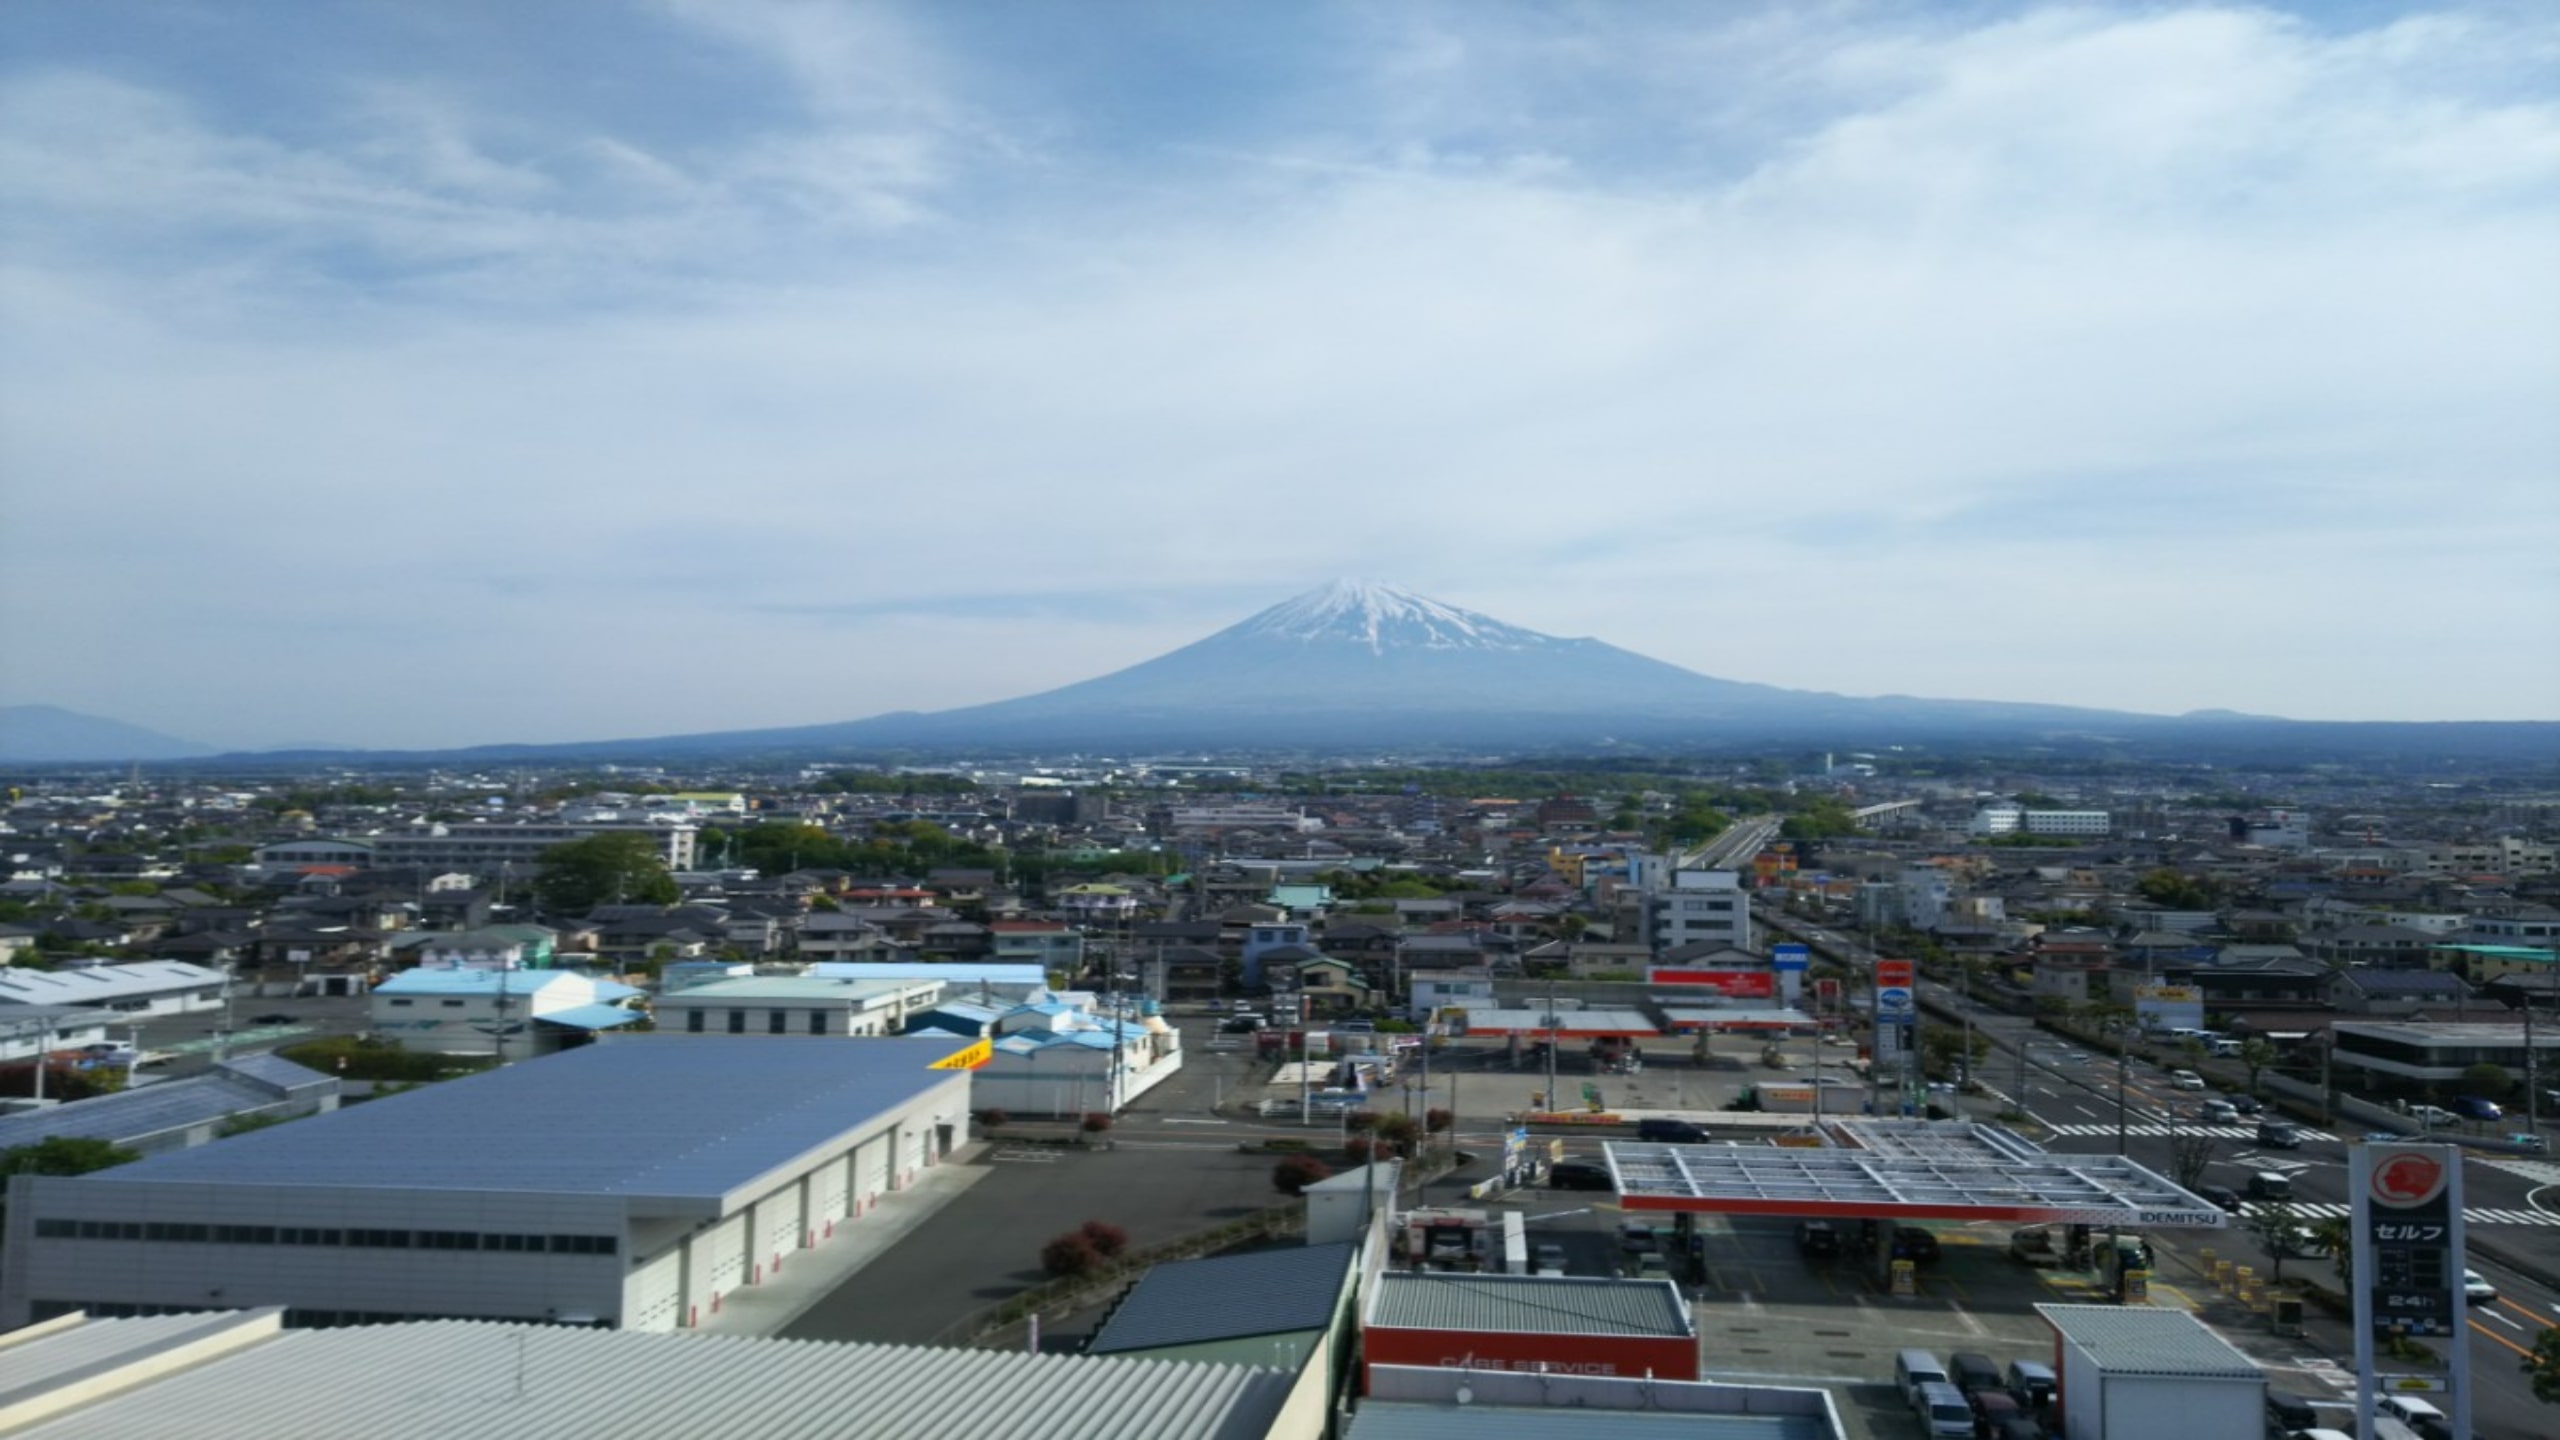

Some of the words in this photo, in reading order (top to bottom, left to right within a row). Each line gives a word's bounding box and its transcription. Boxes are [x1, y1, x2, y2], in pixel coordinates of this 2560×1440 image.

[2139, 1212, 2217, 1225] IDEMITSU
[2375, 1224, 2443, 1240] セルフ
[1513, 1360, 1616, 1375] SERVICE
